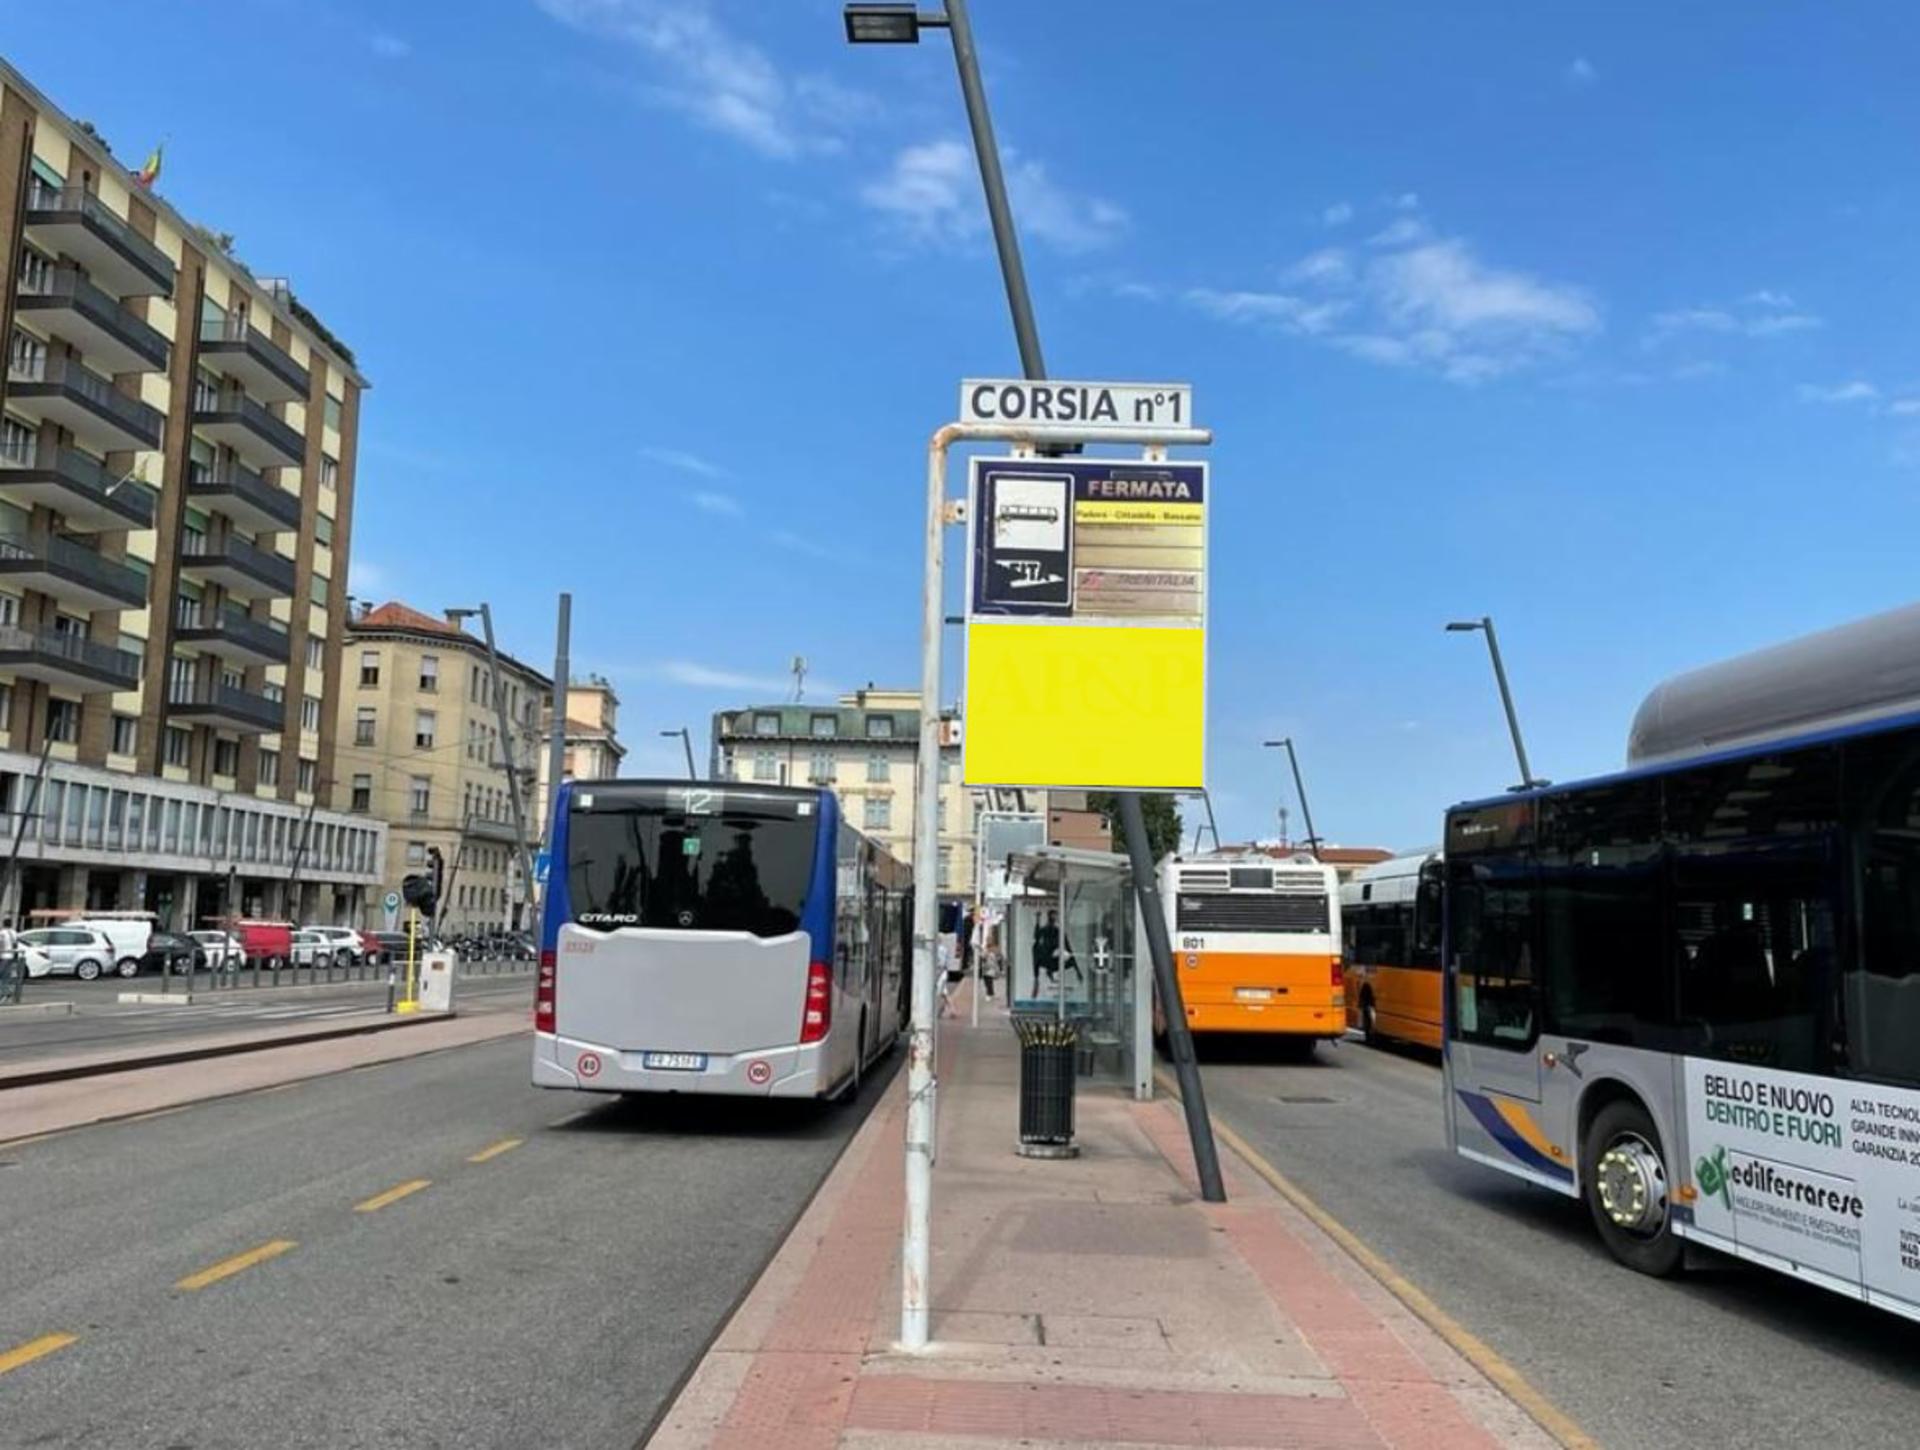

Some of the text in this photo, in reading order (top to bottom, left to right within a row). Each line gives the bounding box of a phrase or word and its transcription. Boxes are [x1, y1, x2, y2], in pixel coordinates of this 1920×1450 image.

[971, 386, 1119, 422] CORSIA
[1088, 479, 1191, 499] FERMATA
[684, 789, 712, 814] 12
[579, 912, 638, 923] CITARO
[1182, 936, 1205, 949] 801
[1704, 1074, 1834, 1119] BELLO E NUOVO
[1850, 1099, 1876, 1116] ALTA
[1706, 1100, 1843, 1148] DENTRO E FUORI
[1851, 1118, 1896, 1141] GRANDE
[1852, 1140, 1909, 1164] GARANZIA
[1731, 1160, 1864, 1218] edilferrarese
